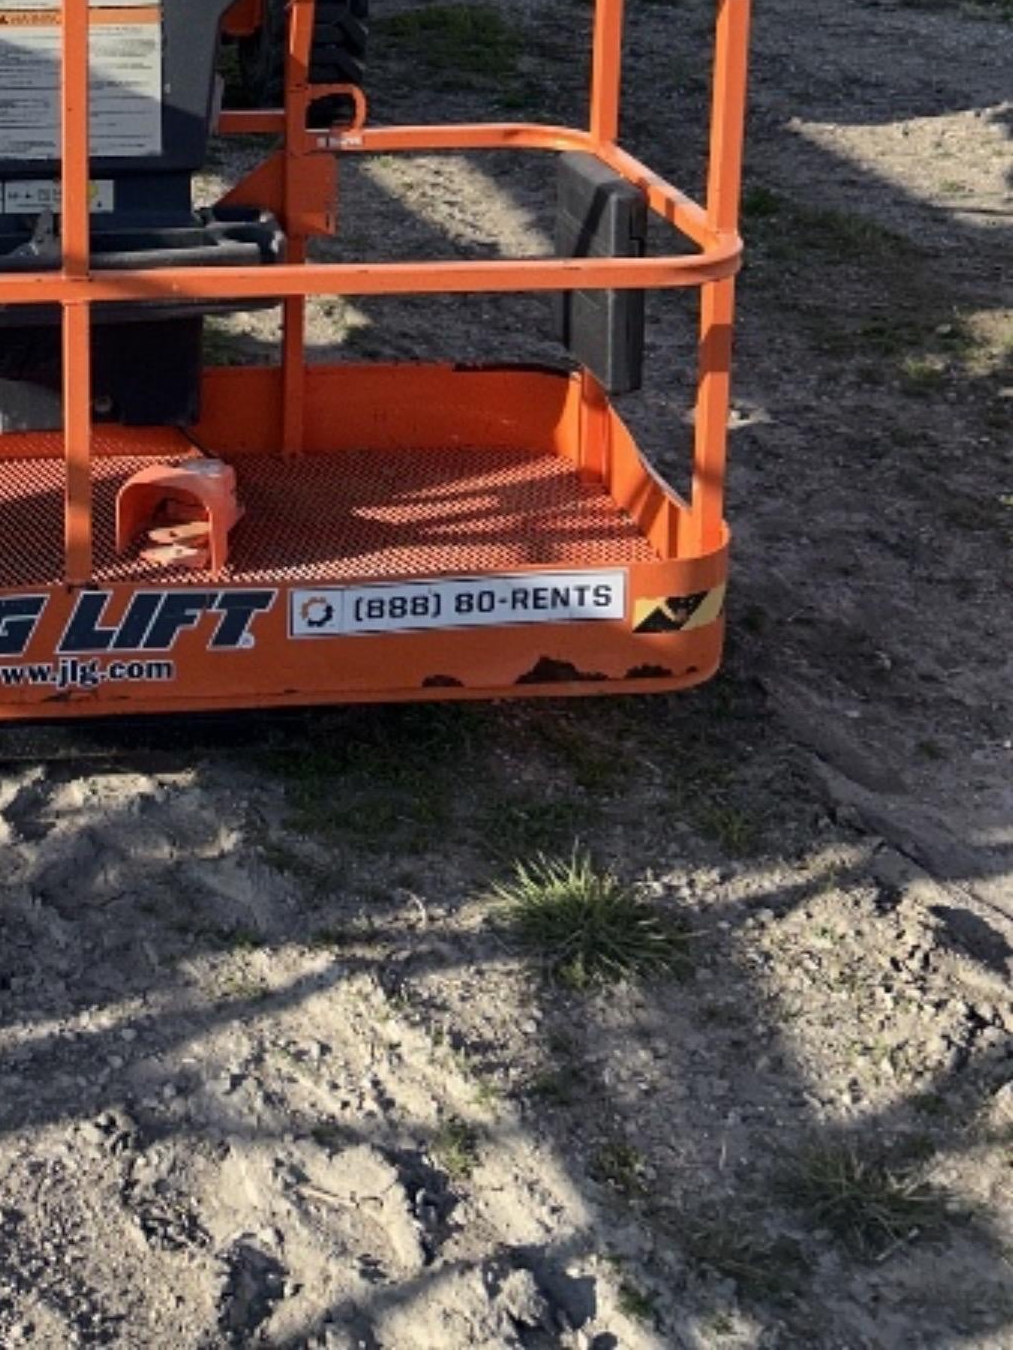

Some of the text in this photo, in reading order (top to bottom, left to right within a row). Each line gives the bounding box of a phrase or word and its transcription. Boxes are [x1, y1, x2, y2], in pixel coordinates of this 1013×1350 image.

[55, 588, 278, 654] LIFT
[353, 584, 613, 623] (888) 80-RENTS
